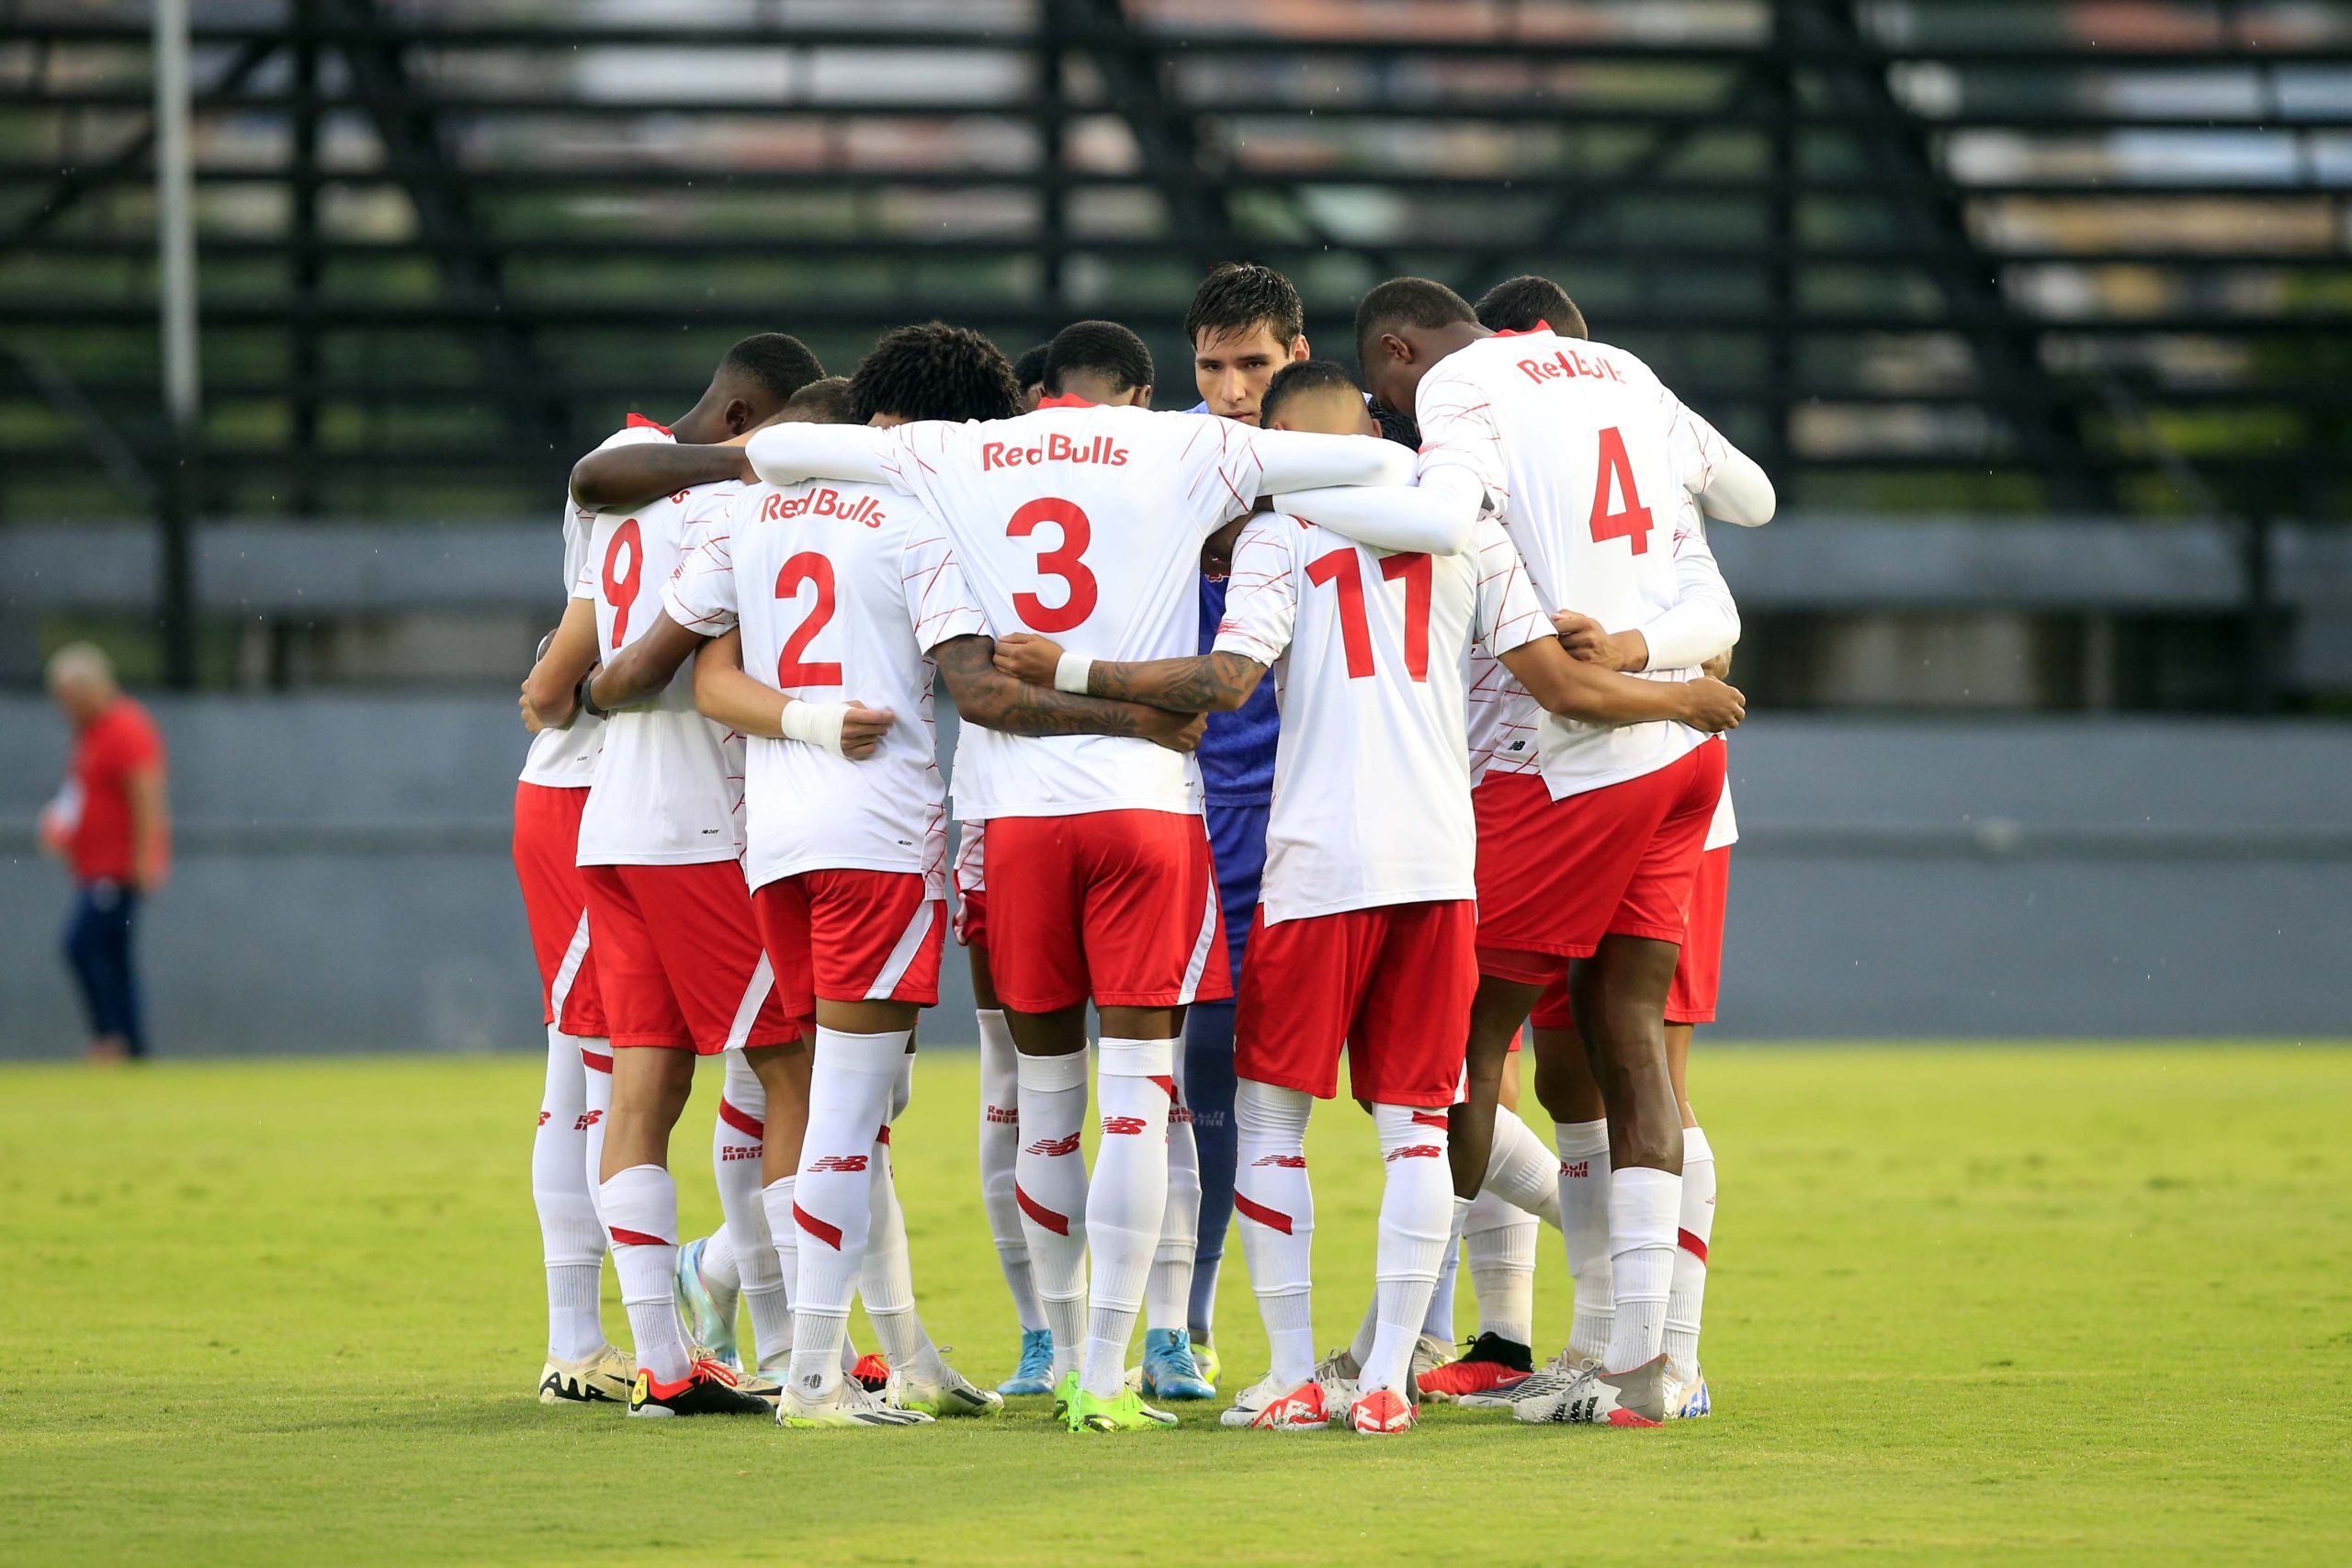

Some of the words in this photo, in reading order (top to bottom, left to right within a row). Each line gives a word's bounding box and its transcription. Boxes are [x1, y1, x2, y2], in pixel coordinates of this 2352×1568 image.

[1589, 426, 1654, 556] 4
[602, 518, 643, 649] 9
[775, 551, 842, 689] 2
[1006, 497, 1098, 633] 3
[1305, 547, 1432, 682] 11
